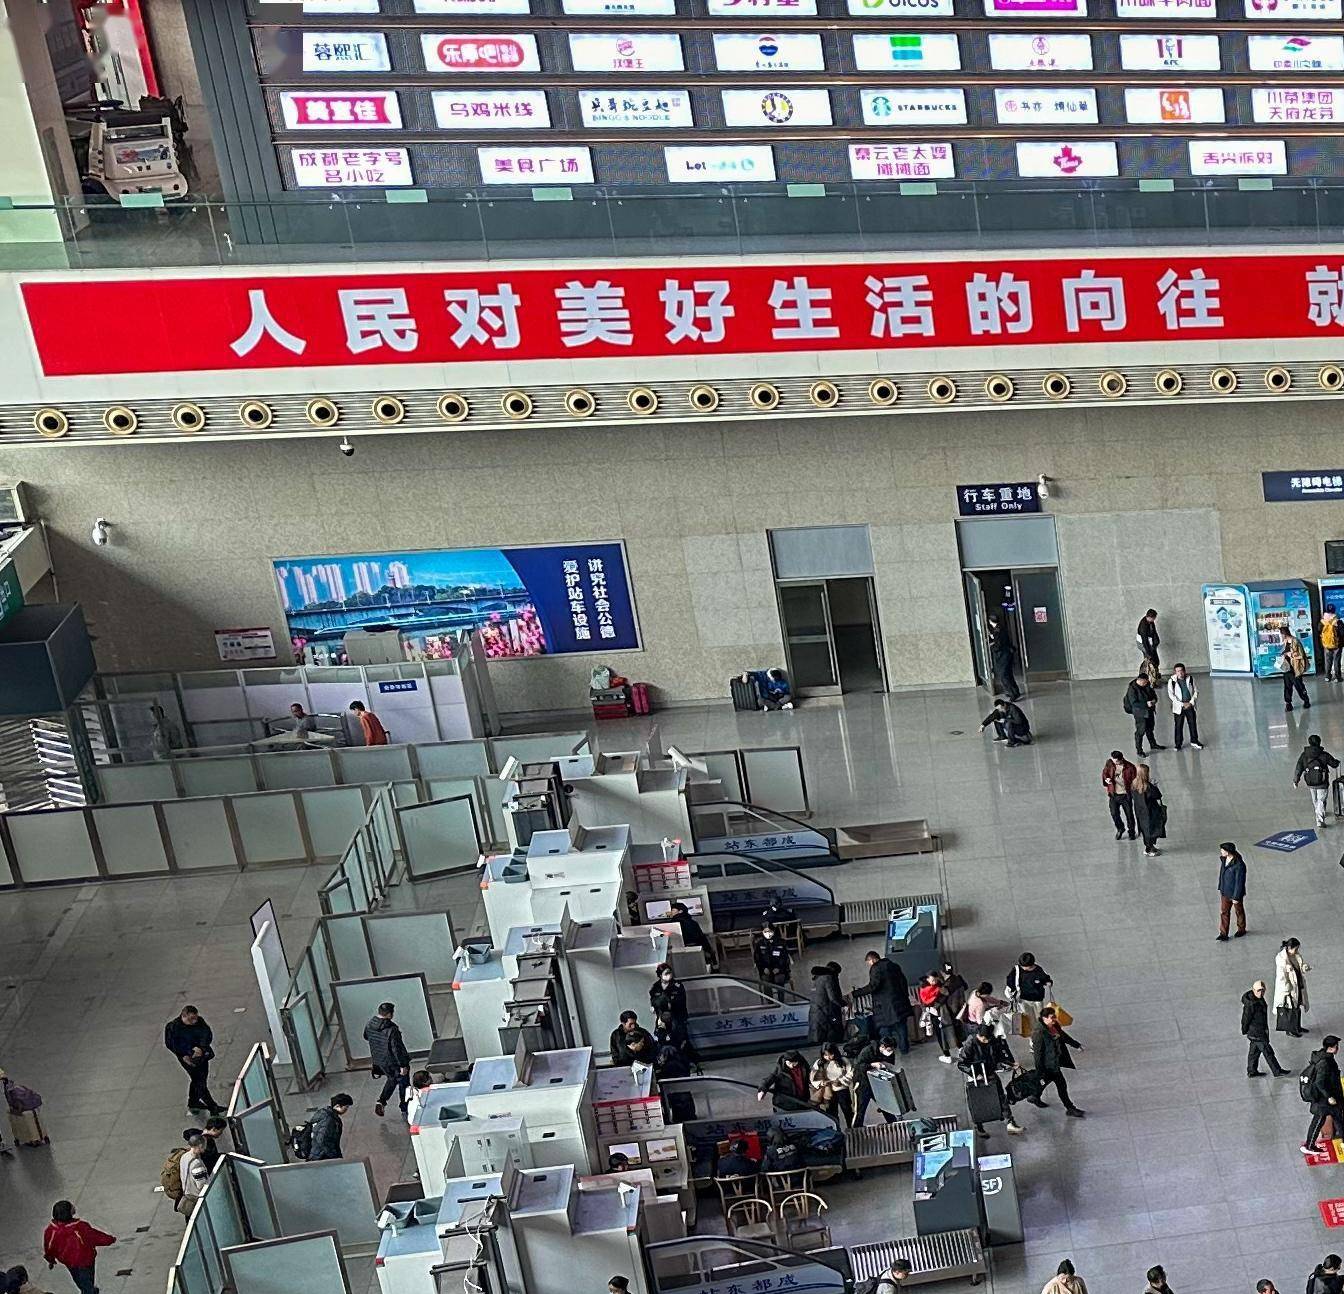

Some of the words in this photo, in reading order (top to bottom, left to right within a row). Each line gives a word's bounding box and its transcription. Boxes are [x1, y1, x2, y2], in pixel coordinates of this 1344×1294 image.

[449, 102, 534, 117] 乌鸡米线
[898, 103, 957, 112] STARBUCKS
[299, 152, 402, 167] 成都老字号
[494, 158, 579, 173] 美食广场
[229, 265, 1224, 357] 人民对美好生活的向往
[1290, 474, 1343, 489] 无障碍电梯
[963, 485, 1033, 503] 行车重地
[975, 502, 998, 512] Staff
[1001, 500, 1023, 512] Only
[562, 560, 590, 640] 爱护站车设施
[588, 558, 616, 639] 讲究社会公德
[982, 1179, 998, 1191] SF
